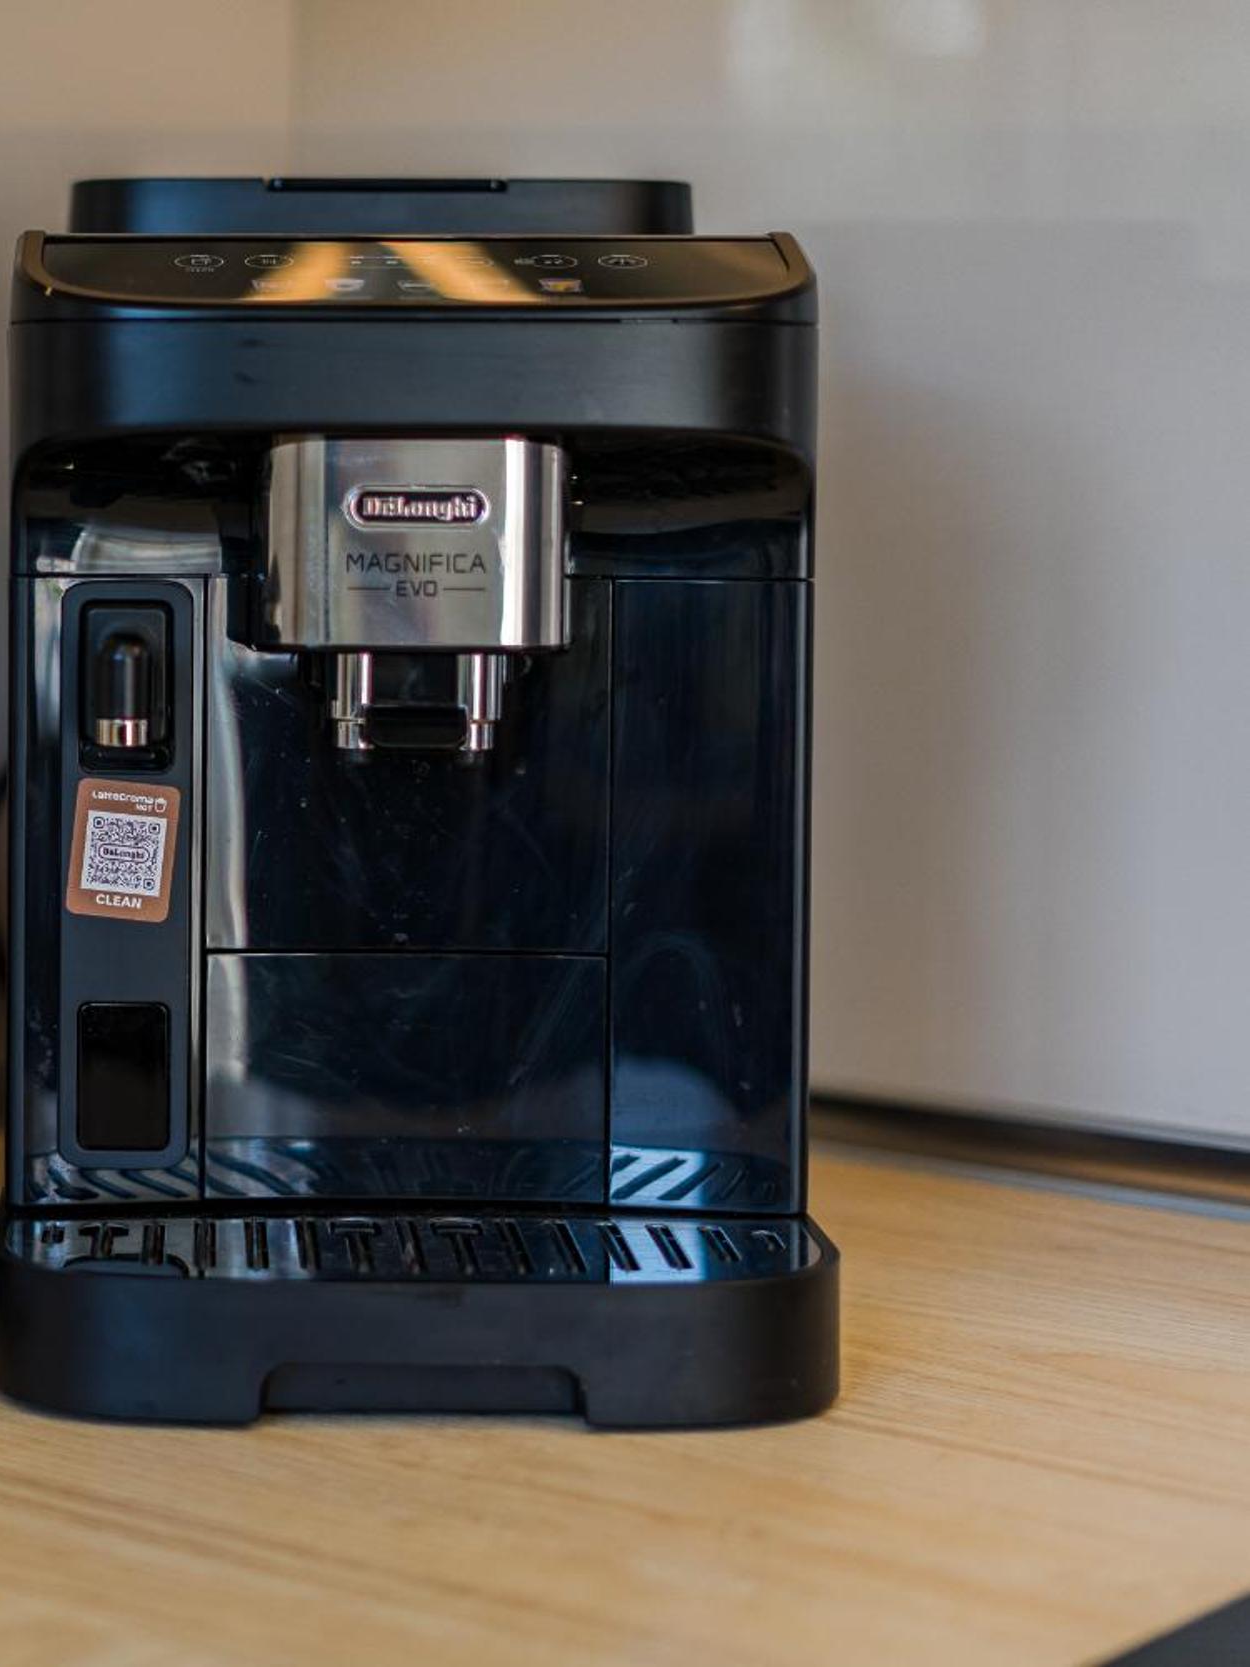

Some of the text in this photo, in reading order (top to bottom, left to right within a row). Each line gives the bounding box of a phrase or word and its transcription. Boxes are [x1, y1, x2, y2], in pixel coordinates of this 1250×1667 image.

[346, 552, 486, 574] MAGNIFICA
[396, 580, 438, 597] EVO
[95, 893, 143, 909] CLEAN
